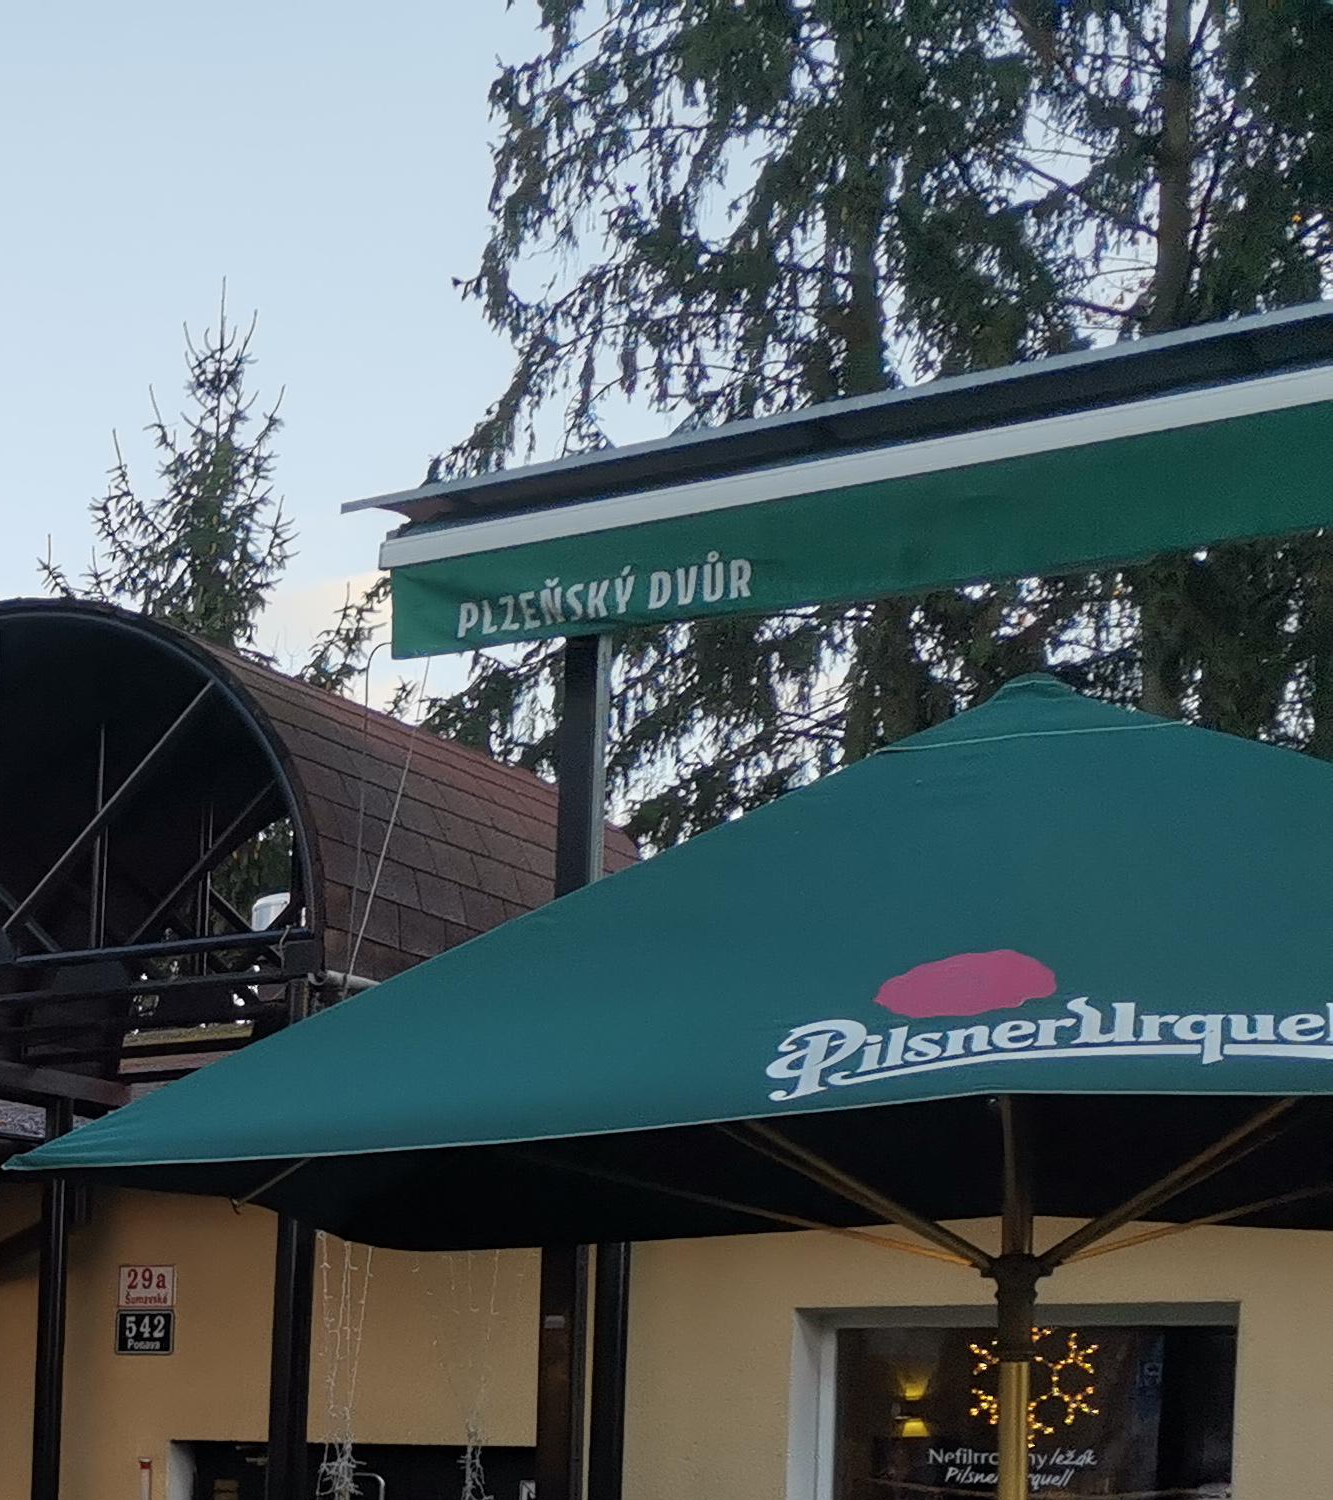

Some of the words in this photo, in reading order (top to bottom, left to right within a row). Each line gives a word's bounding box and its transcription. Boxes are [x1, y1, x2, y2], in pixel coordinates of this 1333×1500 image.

[456, 566, 636, 639] PLZEŇSKÝ
[648, 551, 753, 611] DVŮR
[765, 1017, 1078, 1103] Pilsner
[127, 1267, 167, 1290] 29a
[125, 1315, 166, 1338] 542
